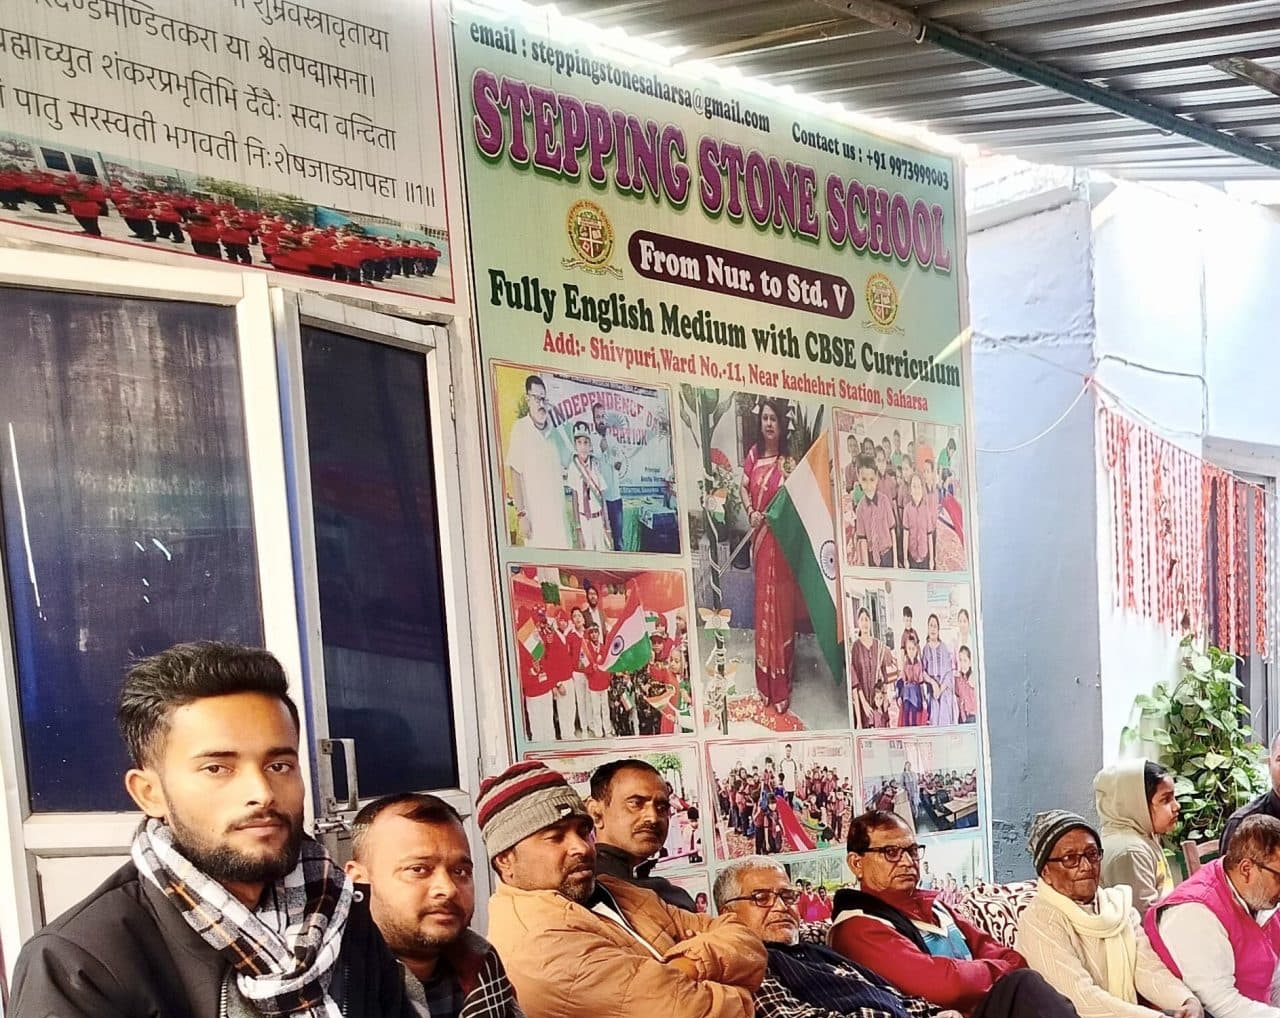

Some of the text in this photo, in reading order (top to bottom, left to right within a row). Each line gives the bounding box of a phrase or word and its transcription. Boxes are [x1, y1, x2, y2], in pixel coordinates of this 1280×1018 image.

[224, 35, 249, 62] या
[470, 22, 517, 54] email
[531, 40, 771, 132] steppingstonesaharsa@gmail.com
[13, 88, 63, 130] पातु
[67, 101, 156, 143] सरस्वती
[163, 124, 238, 162] भगवती
[289, 104, 328, 134] सदा
[334, 112, 396, 150] वन्दिता
[792, 121, 840, 155] Contact
[843, 142, 856, 161] us
[866, 150, 886, 171] +91
[472, 68, 951, 272] STEPPING STONE SCHOOL
[638, 239, 701, 281] From
[704, 254, 754, 294] Nur.
[760, 271, 782, 299] to
[787, 272, 828, 309] Std.
[833, 284, 847, 312] V
[488, 268, 961, 387] Fully English Medium with CBSE Curriculum
[543, 329, 586, 356] Add:-
[748, 364, 779, 388] Near
[782, 370, 836, 398] kachehri
[839, 381, 884, 407] Station,
[886, 389, 929, 411] Saharsa
